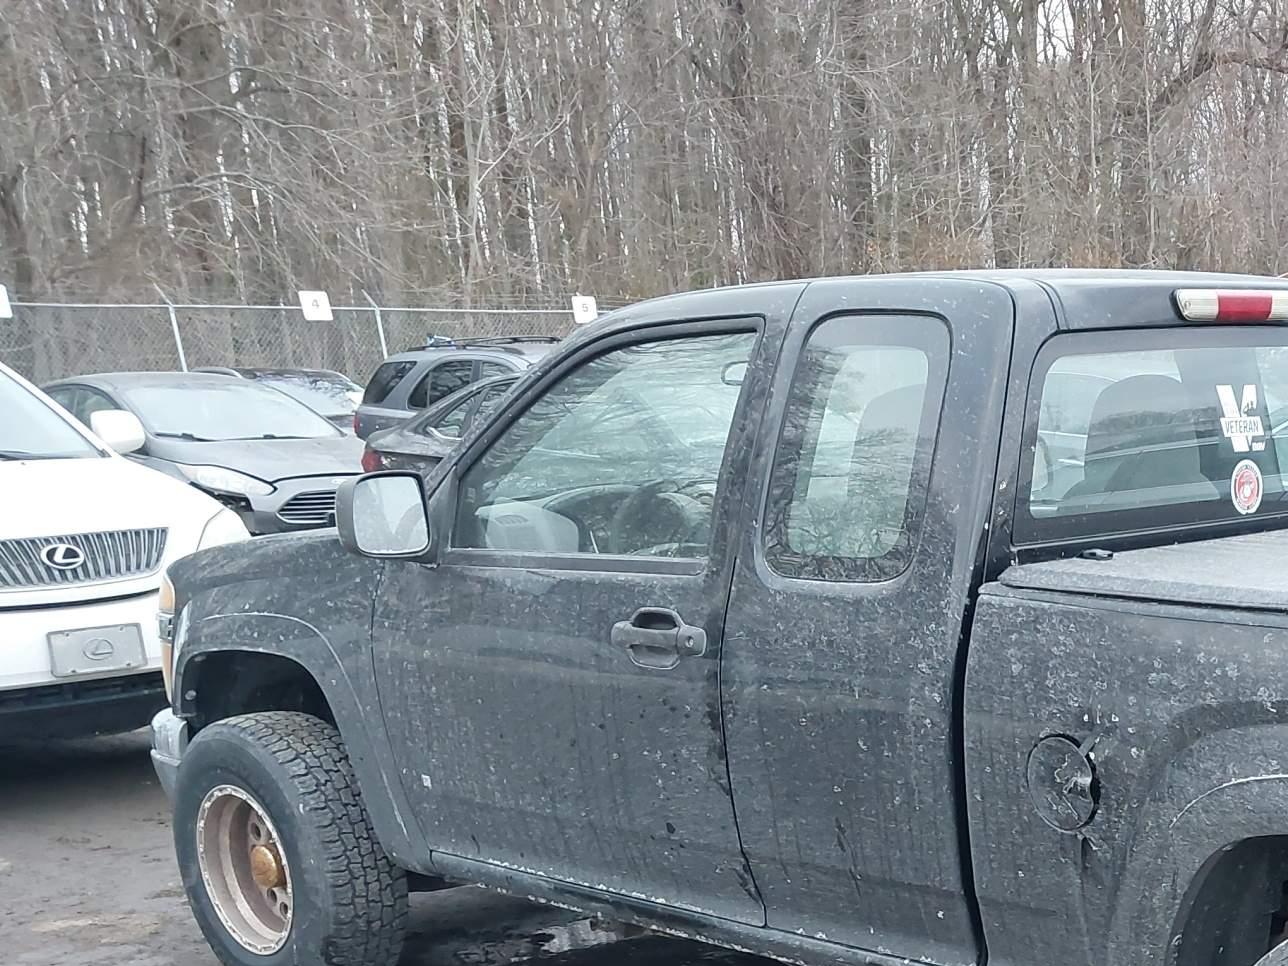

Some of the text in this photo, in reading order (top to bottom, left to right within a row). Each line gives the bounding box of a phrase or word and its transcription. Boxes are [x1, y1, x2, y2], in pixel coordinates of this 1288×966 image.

[312, 299, 320, 308] 4
[582, 303, 589, 312] 5
[1225, 419, 1259, 434] VETERAN
